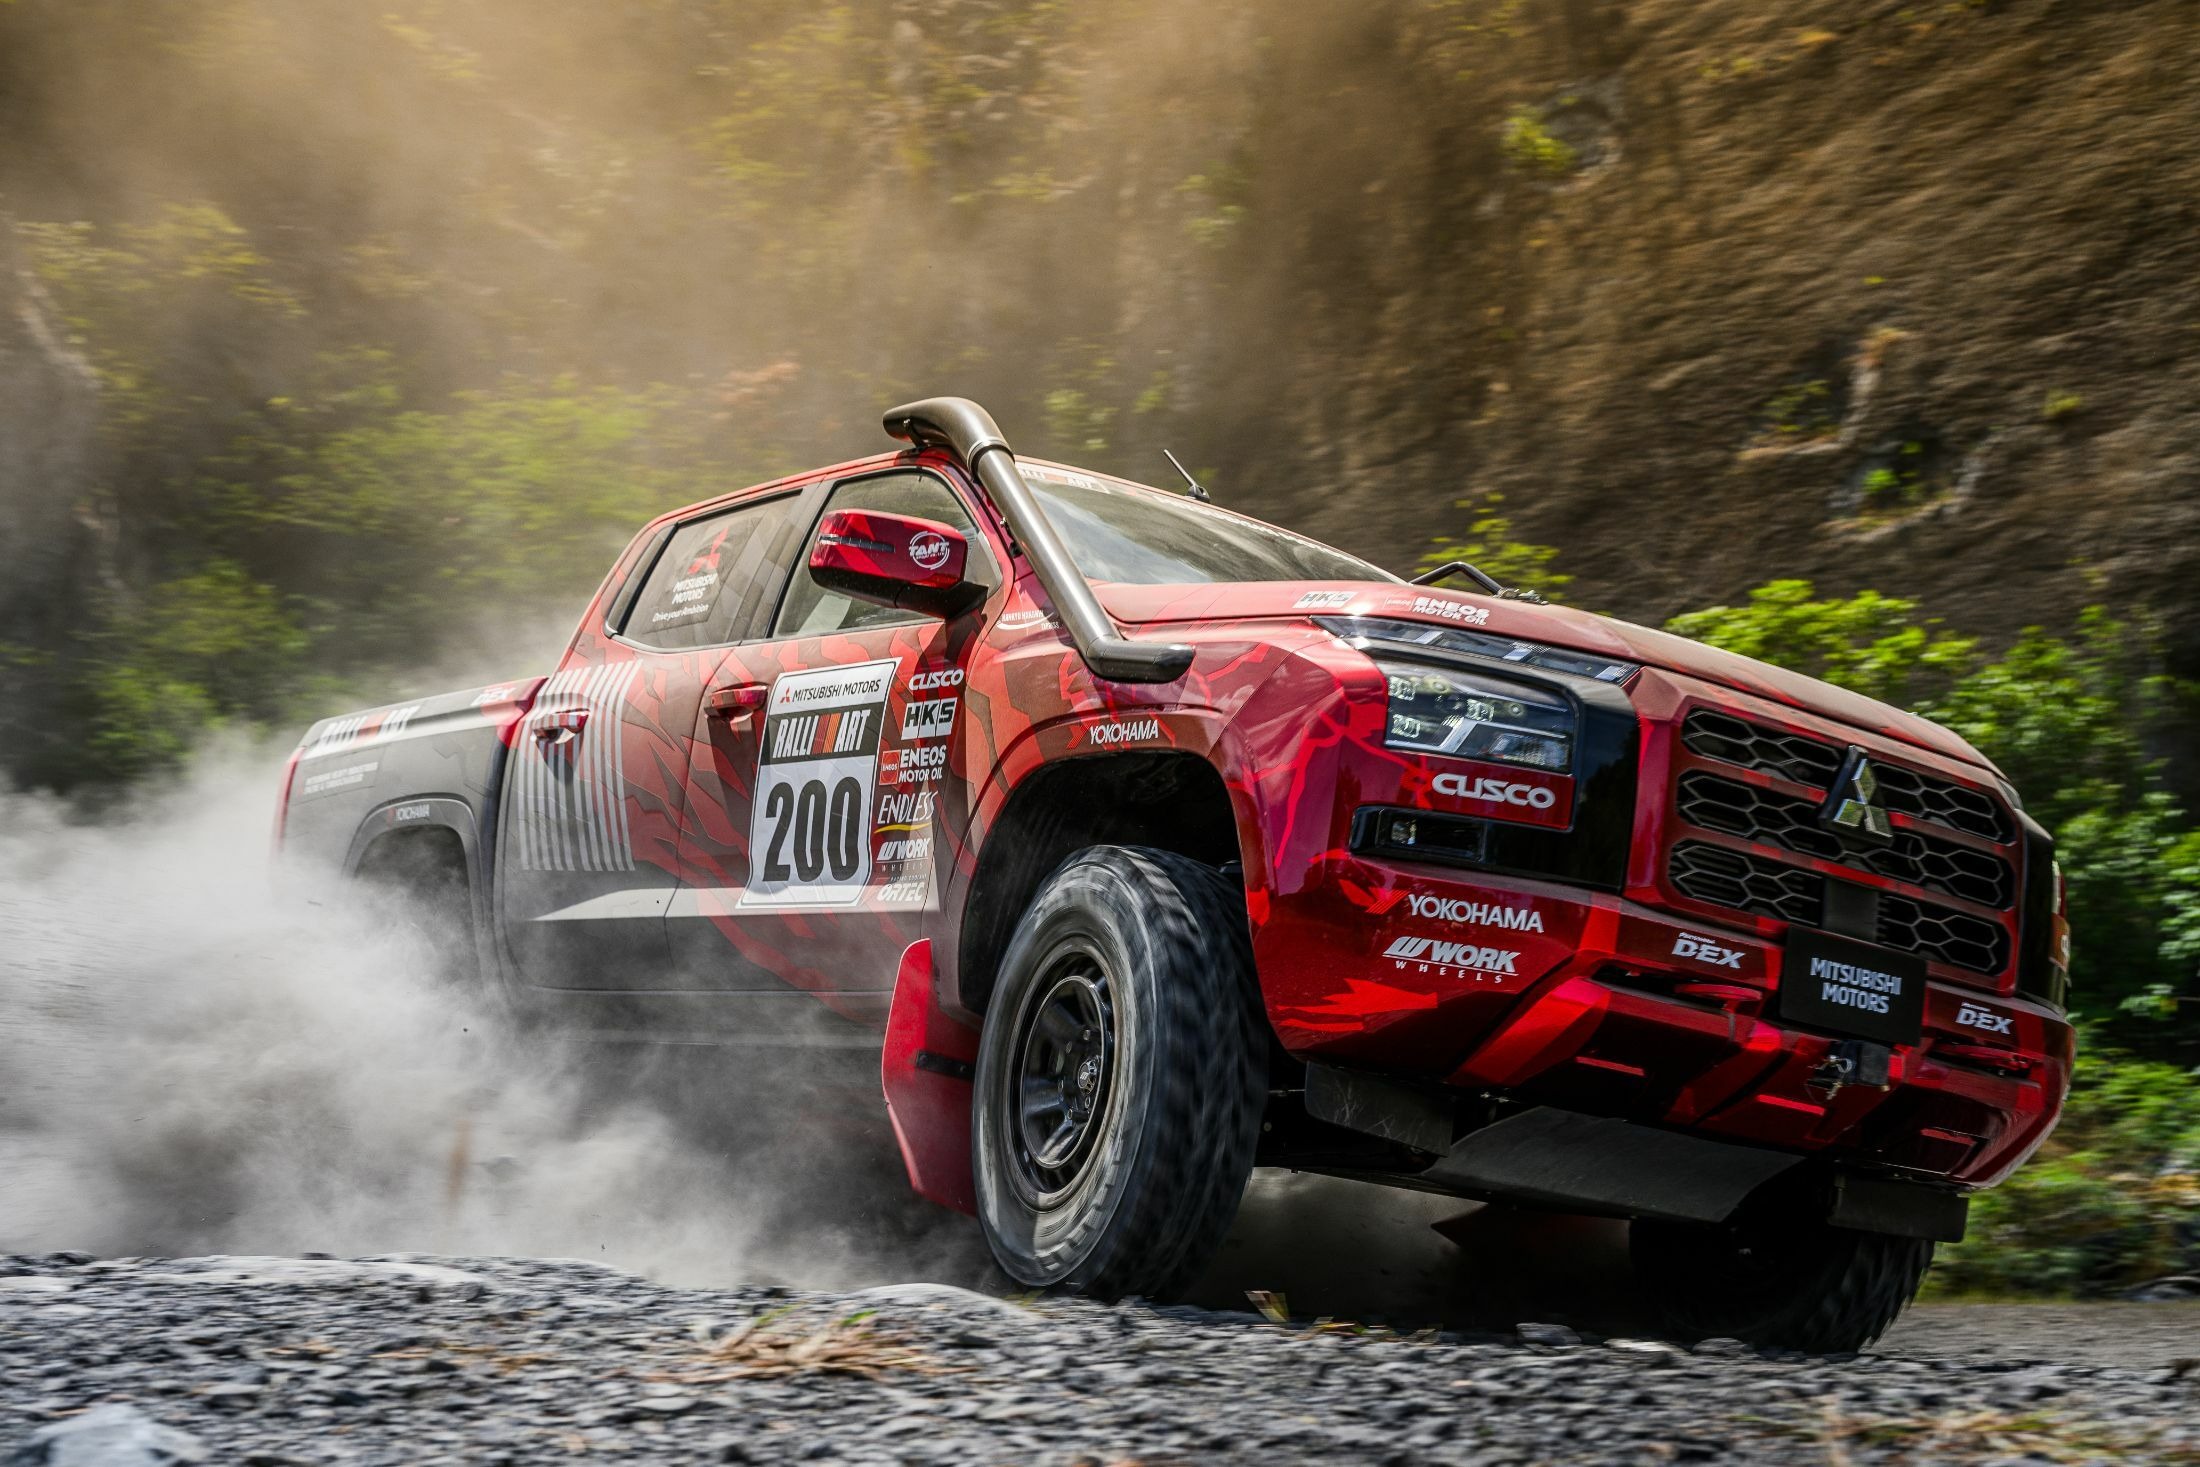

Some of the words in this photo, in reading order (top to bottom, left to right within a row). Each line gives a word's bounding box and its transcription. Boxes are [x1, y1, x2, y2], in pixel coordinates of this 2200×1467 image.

[909, 541, 950, 557] TANT
[673, 572, 718, 592] MITSUBISHI
[672, 587, 706, 604] MOTORS
[1414, 596, 1490, 619] ENEOS
[1412, 605, 1462, 621] MOTOR
[1464, 614, 1487, 626] OIL
[792, 686, 842, 702] MITSUBISHI
[843, 678, 882, 695] MOTORS
[908, 669, 965, 691] CUSCO
[904, 700, 956, 728] HKS
[1090, 720, 1159, 745] YOKOHAMA
[882, 763, 898, 772] ENEOS
[900, 745, 947, 769] ENEOS
[898, 769, 930, 784] MOTOR
[931, 767, 943, 780] OIL
[1432, 772, 1556, 809] CUSCO
[877, 790, 939, 825] ENDLESS
[762, 776, 862, 883] 200
[897, 837, 931, 860] WORK
[1408, 893, 1545, 934] YOKOHAMA
[1429, 939, 1522, 974] WORK
[1671, 938, 1746, 969] DEX
[1395, 959, 1503, 984] WHEELS
[1810, 957, 1902, 996] MITSUBISHI
[1821, 982, 1890, 1014] MOTORS
[1955, 1008, 2015, 1035] DEX
